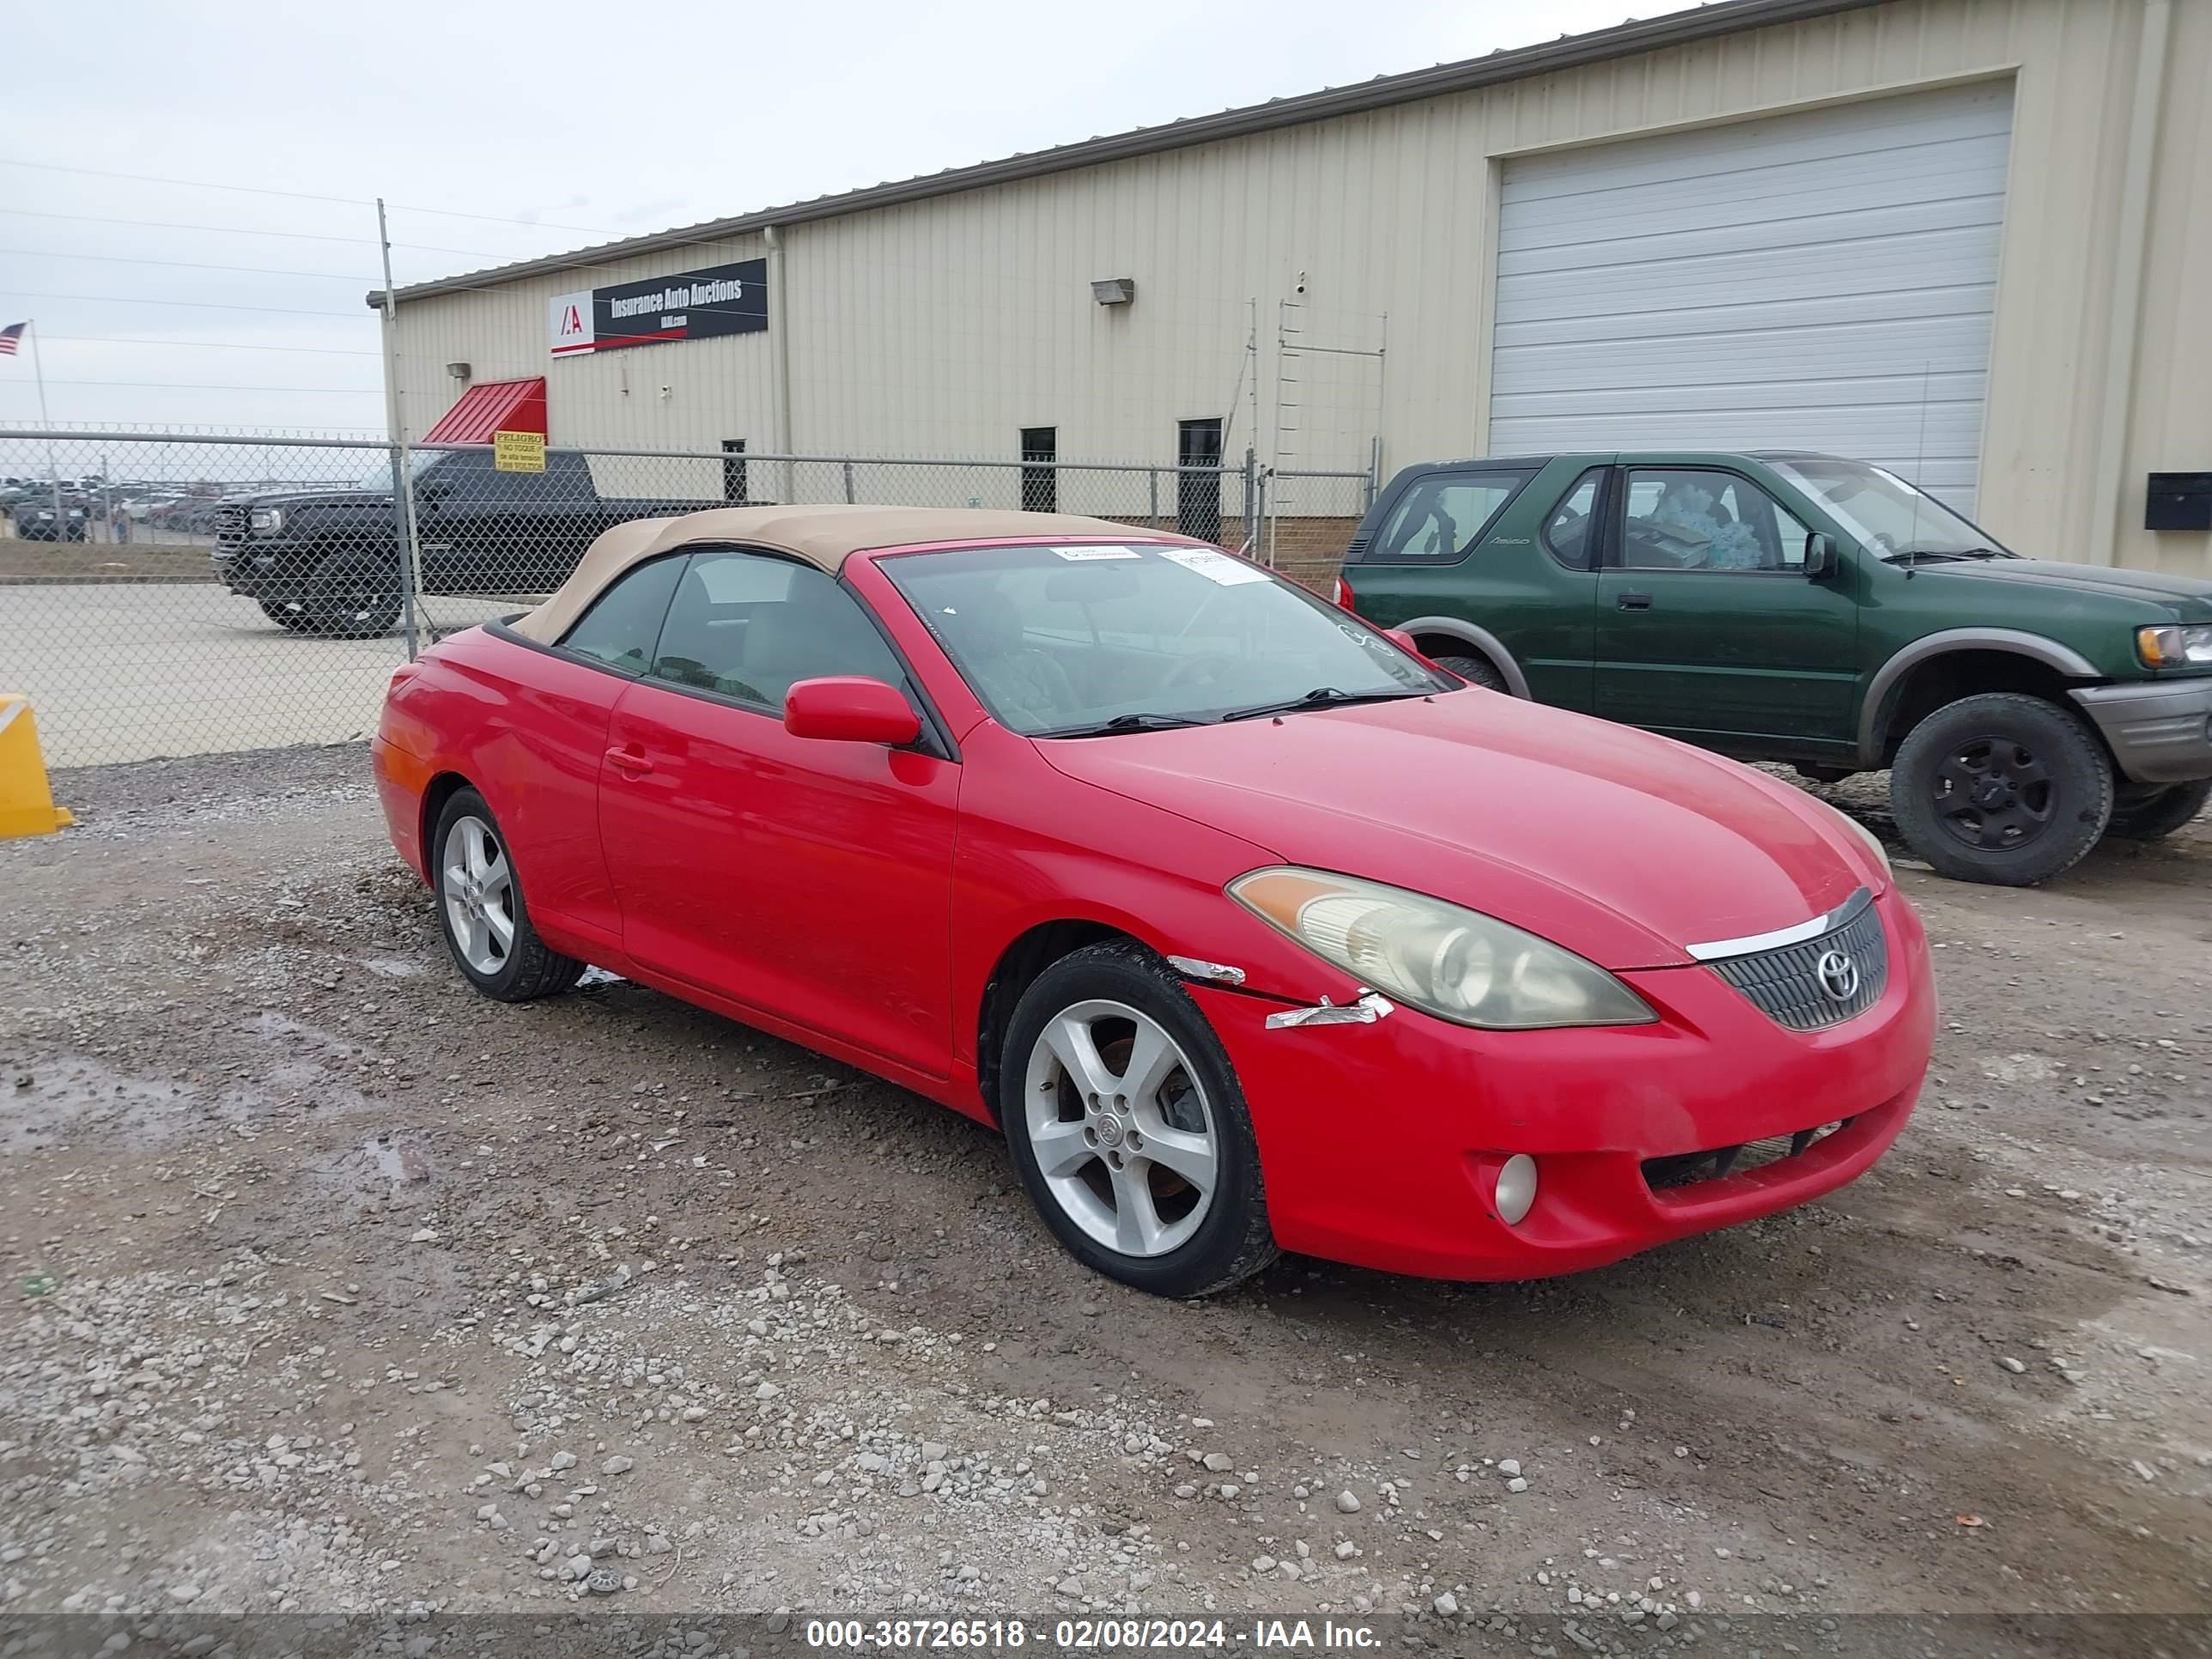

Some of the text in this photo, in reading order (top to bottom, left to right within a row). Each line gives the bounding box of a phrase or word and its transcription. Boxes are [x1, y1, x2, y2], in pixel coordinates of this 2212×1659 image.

[611, 279, 742, 319] Insurance Auto Auctions
[497, 433, 542, 443] PELIGRO
[514, 444, 537, 453] TOQUE
